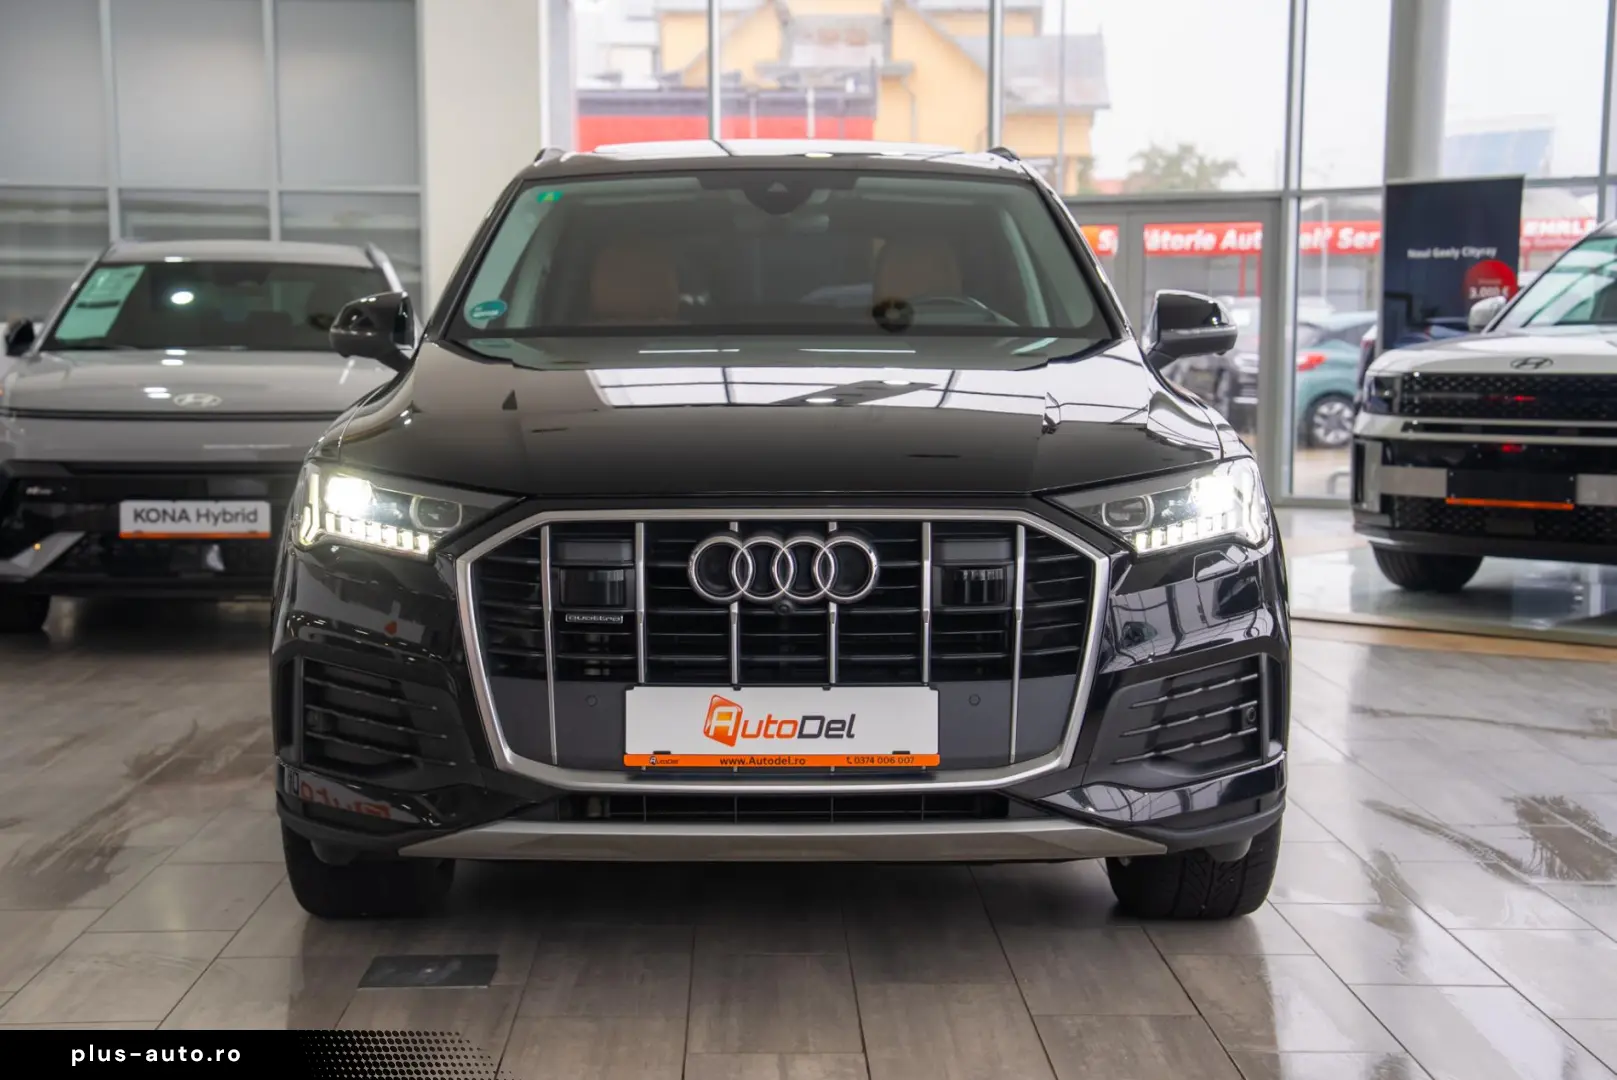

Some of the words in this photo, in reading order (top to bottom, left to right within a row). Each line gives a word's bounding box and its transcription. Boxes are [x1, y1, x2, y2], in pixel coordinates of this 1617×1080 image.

[1219, 227, 1263, 250] Aut
[1336, 227, 1381, 250] Ser
[1432, 247, 1460, 260] Geely
[133, 507, 191, 523] KONA
[196, 507, 258, 526] Hybrid
[703, 694, 856, 747] AutoDel
[719, 755, 806, 766] www.Autodel.ro
[854, 756, 875, 765] 0374
[877, 756, 896, 765] 006
[897, 756, 915, 765] 007
